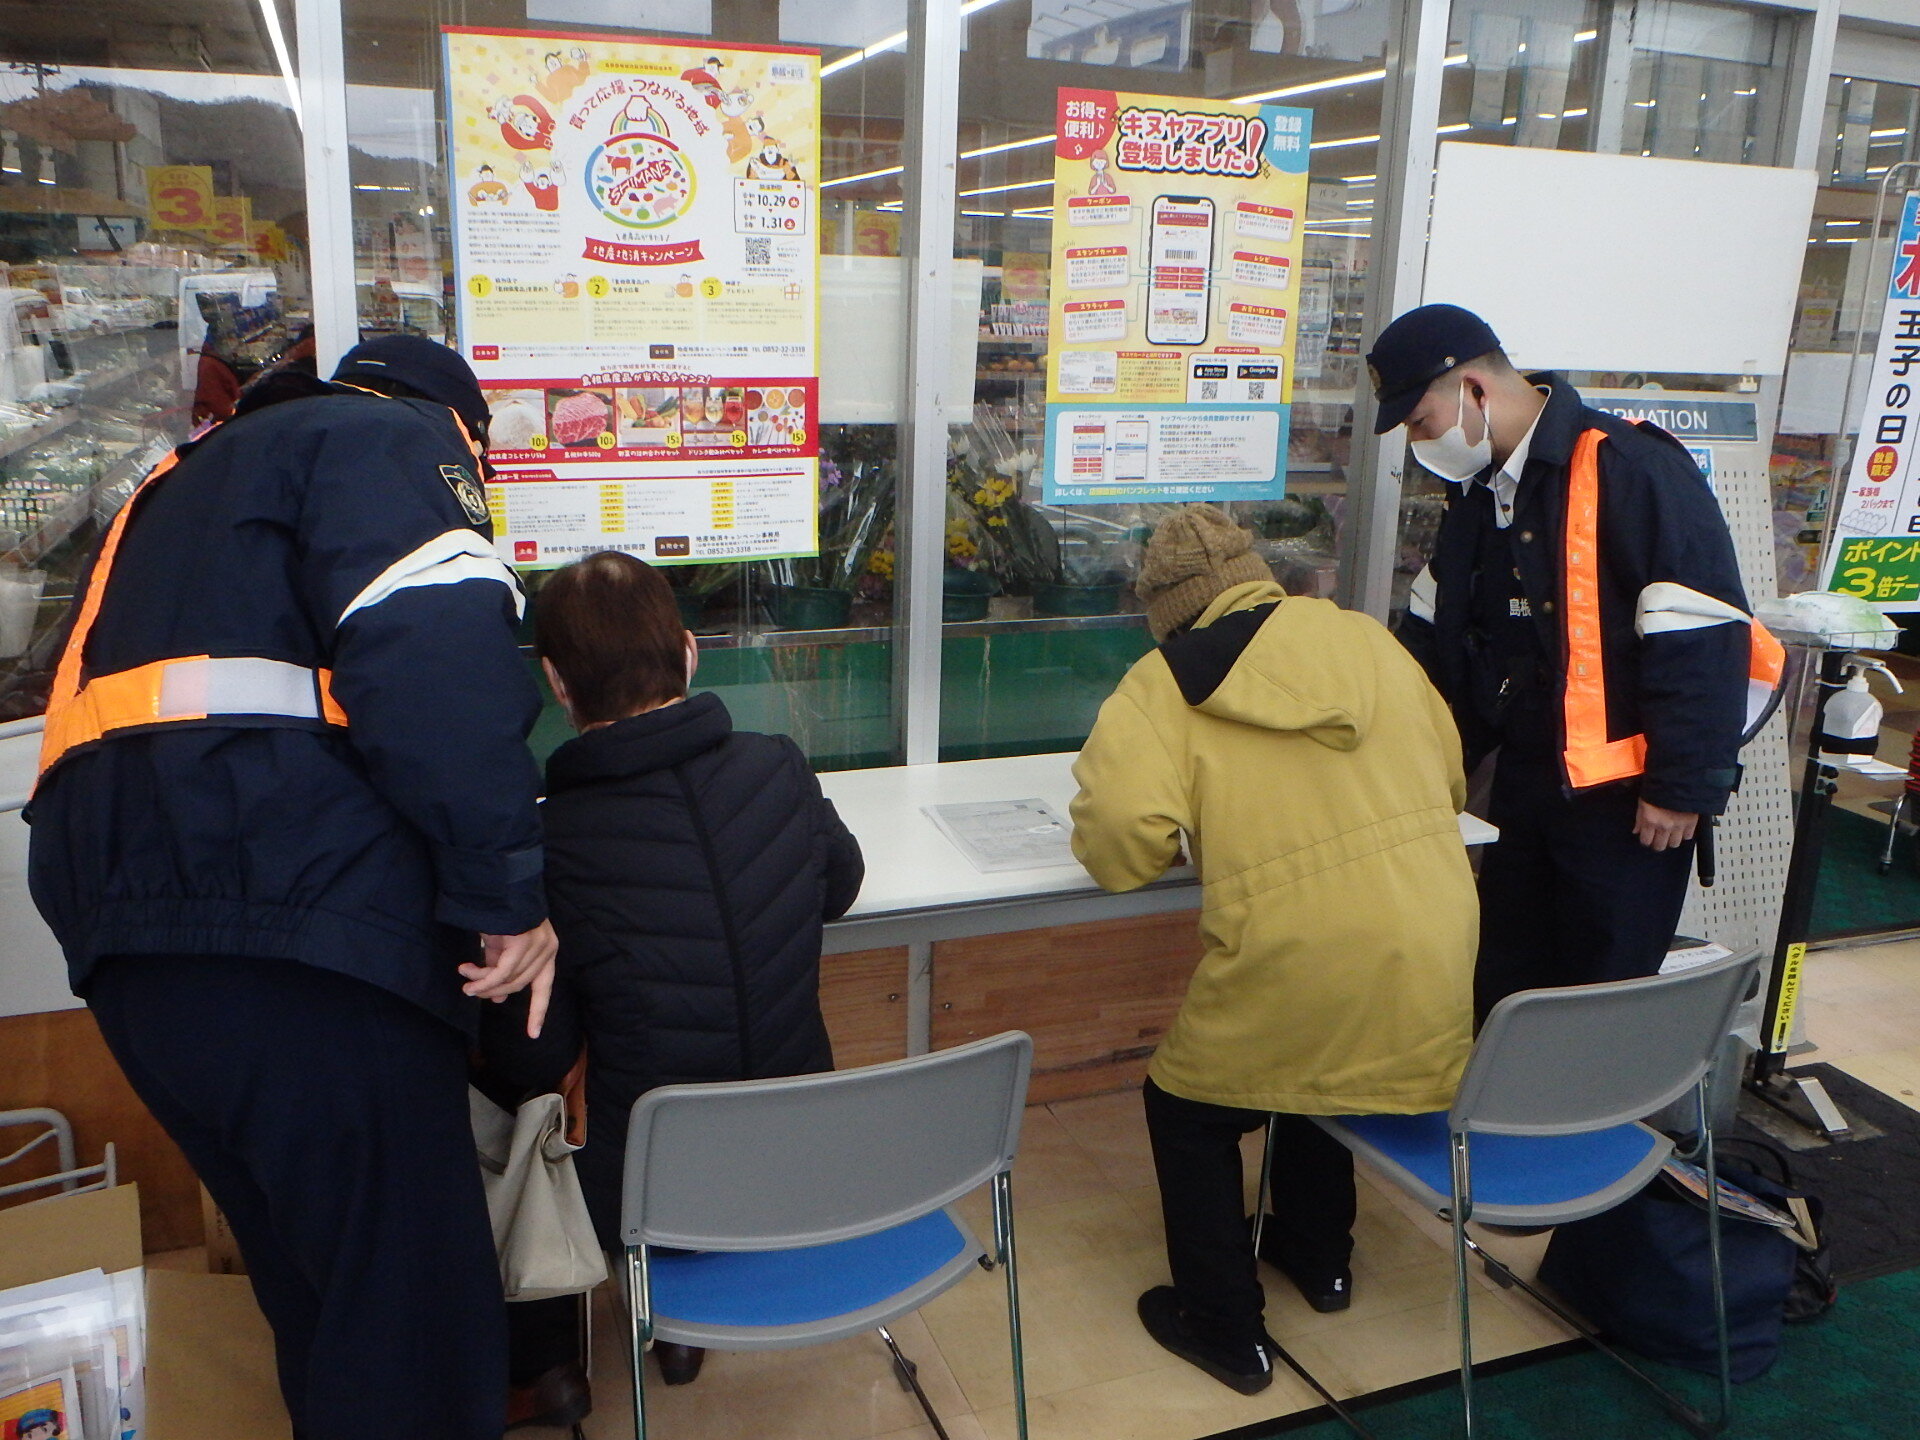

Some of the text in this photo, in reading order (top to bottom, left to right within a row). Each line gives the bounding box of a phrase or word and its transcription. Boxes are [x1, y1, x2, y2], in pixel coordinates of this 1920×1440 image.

[1066, 101, 1107, 119] お得で
[1123, 113, 1243, 143] キヌヤアプリ
[1274, 115, 1302, 133] 登録
[1273, 135, 1301, 152] 無料
[758, 194, 786, 207] 10.29
[761, 217, 782, 229] 1.31
[593, 245, 693, 261] 地産地消キャンペーン
[1249, 367, 1266, 375] Google
[1876, 310, 1920, 444] 玉子の日
[1861, 499, 1895, 509] 2パックまで
[1844, 540, 1920, 563] ポイント
